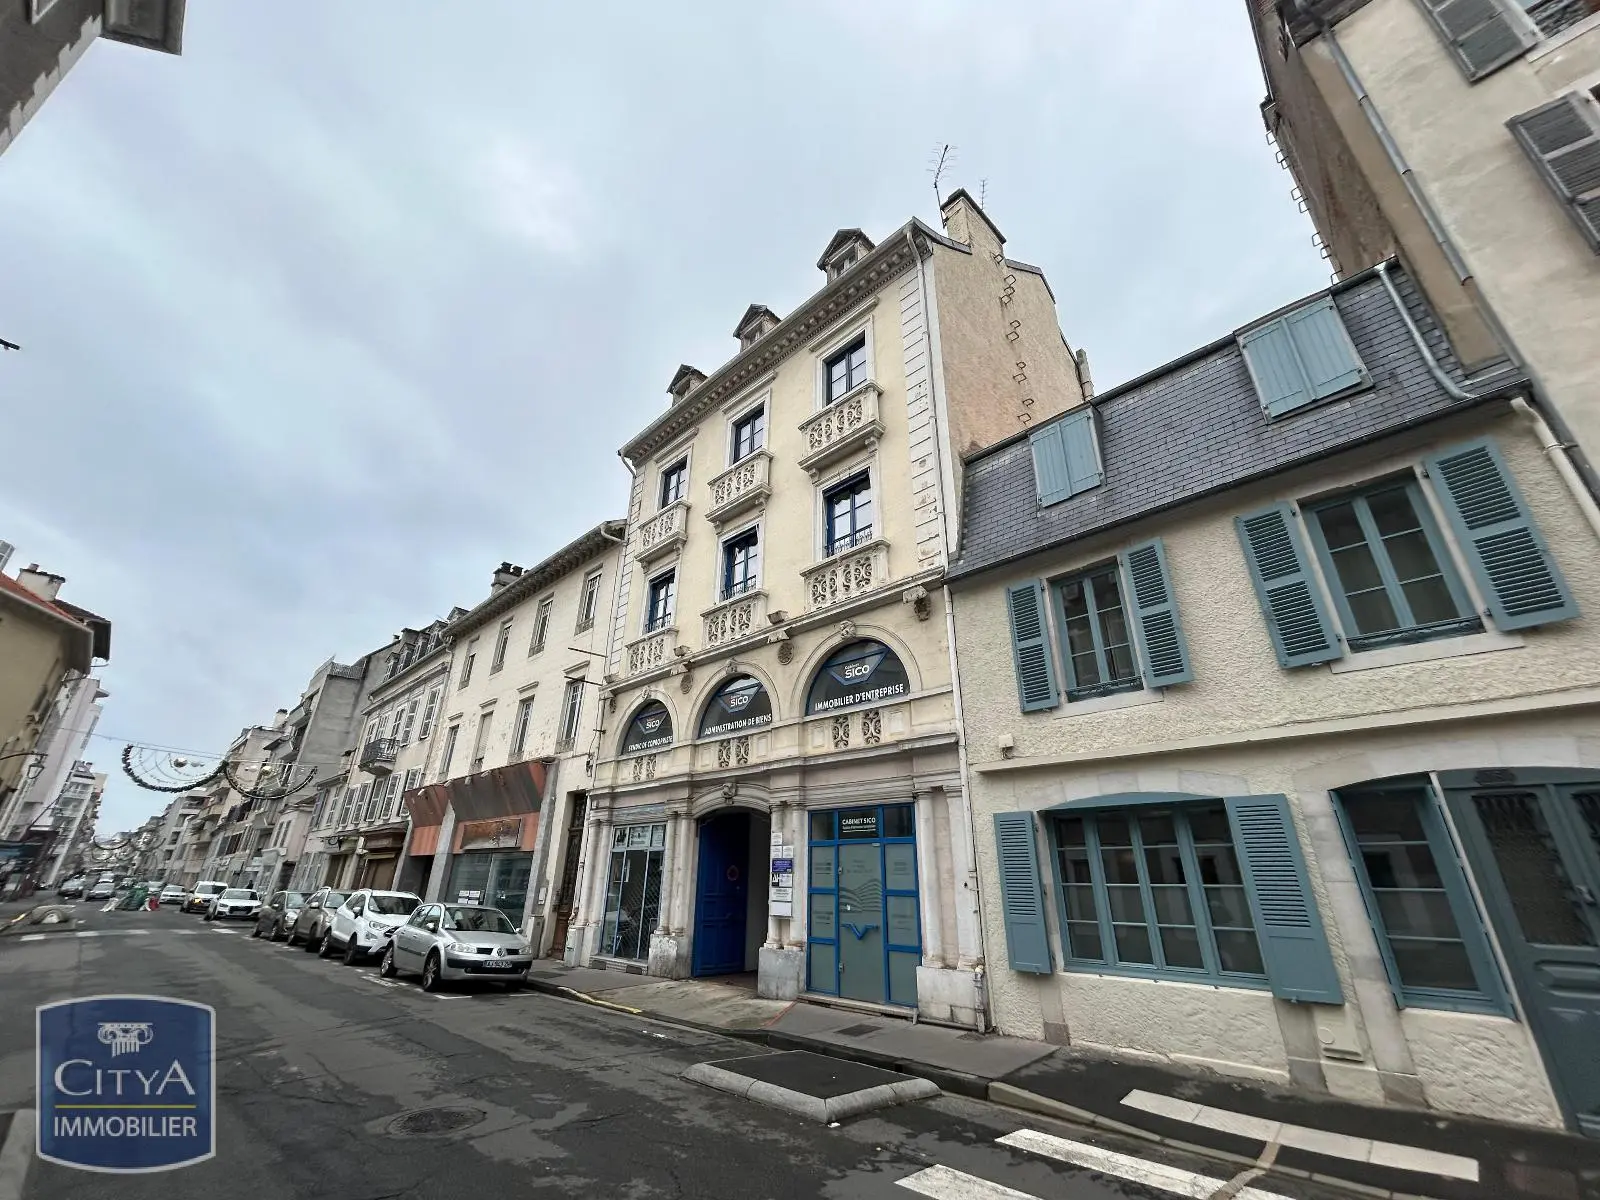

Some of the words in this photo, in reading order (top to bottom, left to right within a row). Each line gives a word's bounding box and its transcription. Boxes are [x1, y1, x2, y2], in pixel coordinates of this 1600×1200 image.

[845, 664, 870, 679] SICO
[730, 695, 749, 707] SICO
[814, 695, 854, 711] IMMOBILIER
[855, 683, 904, 704] D'ENTREPRISE
[645, 719, 660, 729] SICO
[704, 719, 747, 735] ADMINISTRATION
[747, 718, 755, 726] DE
[755, 713, 772, 724] BIENS
